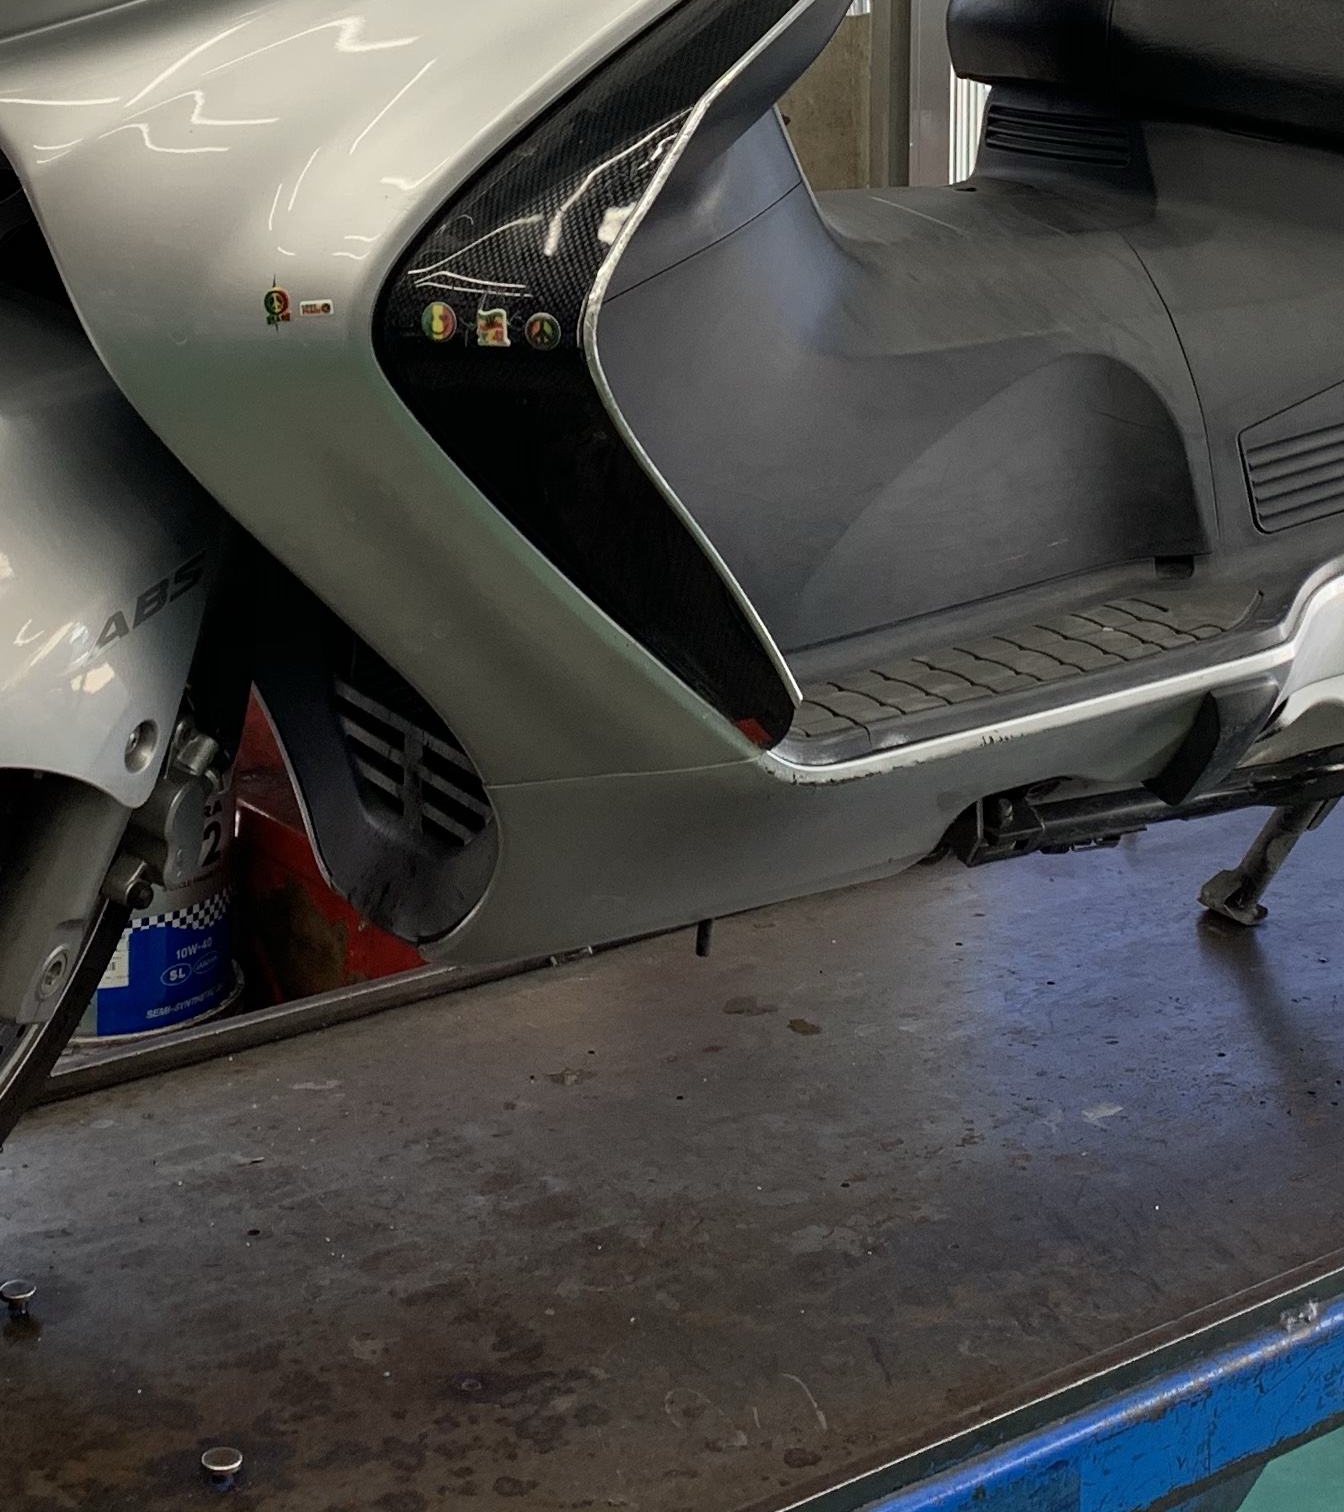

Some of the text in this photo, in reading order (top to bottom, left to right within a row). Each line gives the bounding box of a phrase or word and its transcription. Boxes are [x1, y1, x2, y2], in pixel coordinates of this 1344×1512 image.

[84, 548, 208, 664] ABS
[175, 936, 214, 961] 10W-40
[169, 967, 186, 982] SL
